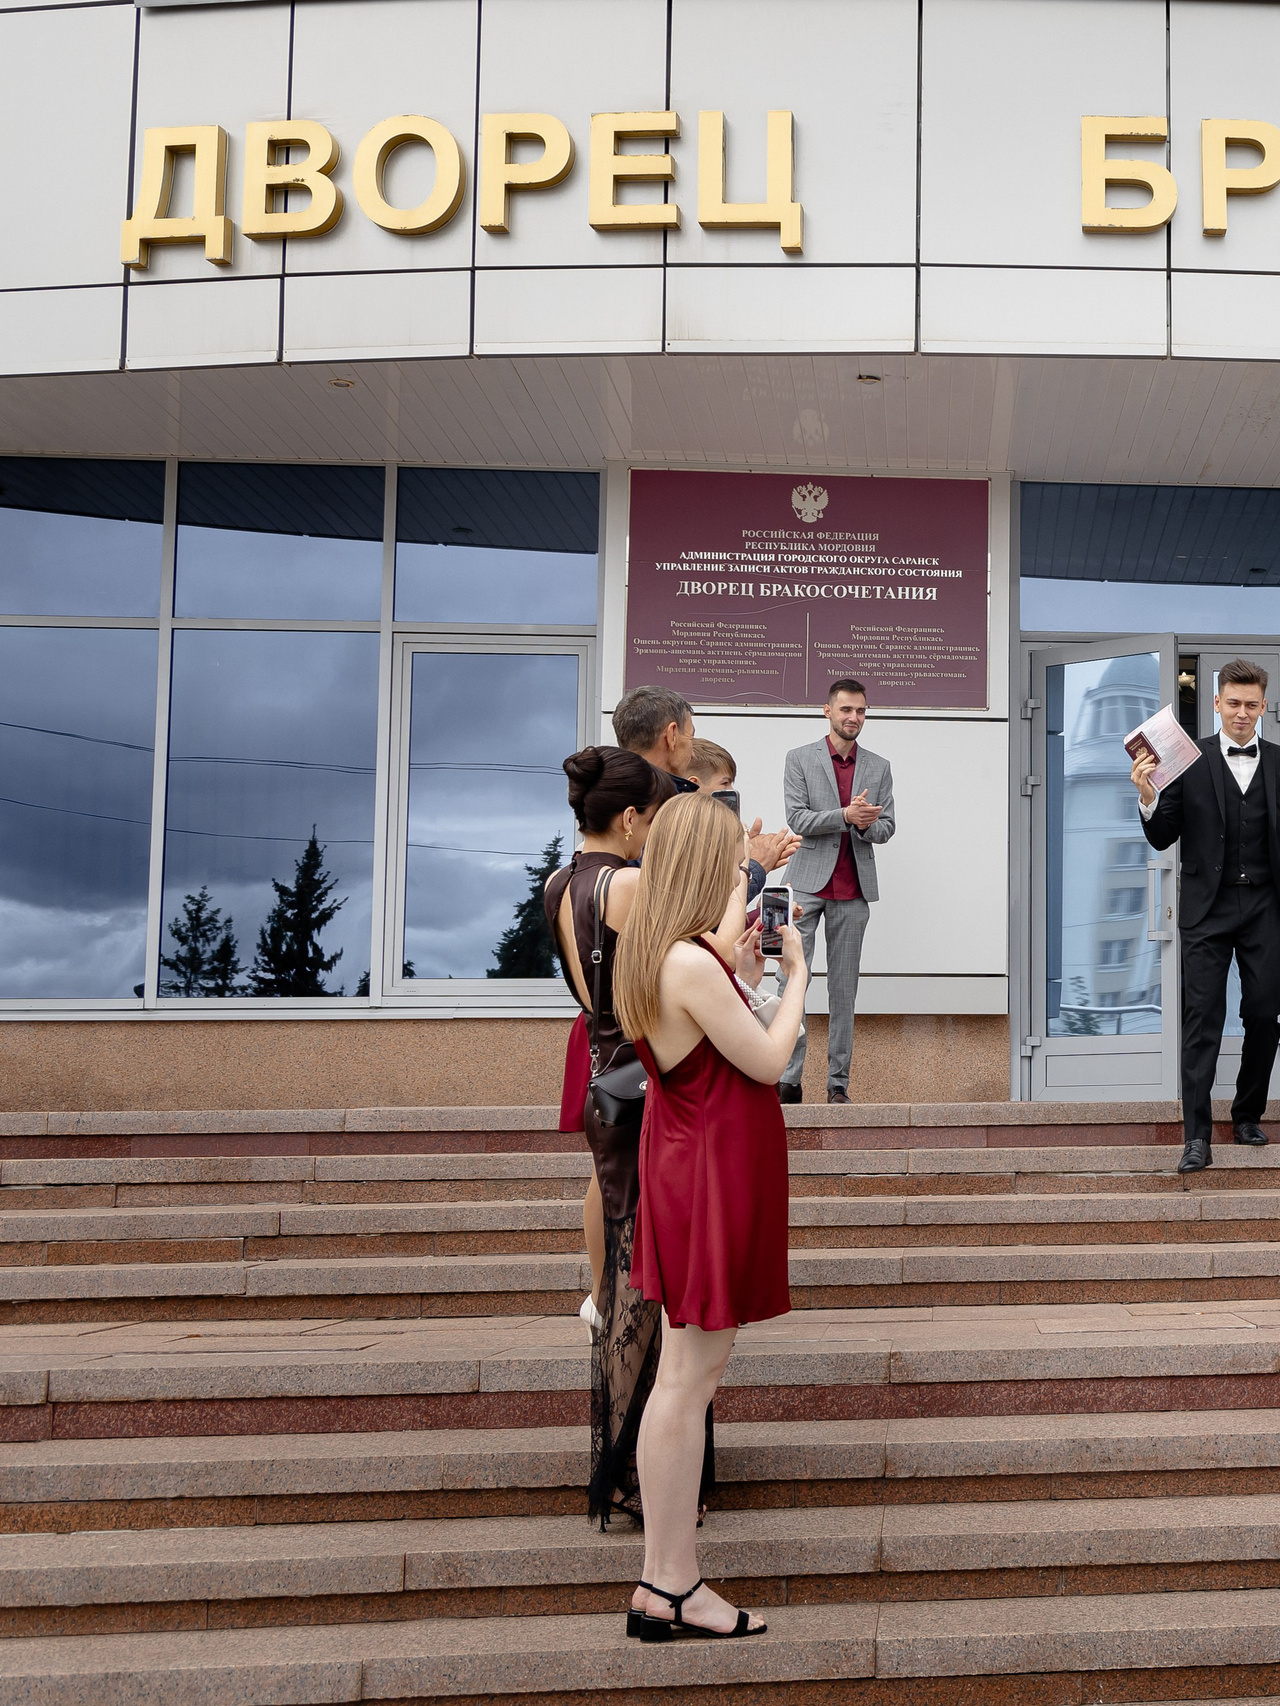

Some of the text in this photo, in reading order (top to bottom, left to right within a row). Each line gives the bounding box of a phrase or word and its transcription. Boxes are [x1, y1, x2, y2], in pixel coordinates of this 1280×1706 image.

[121, 110, 804, 271] ДВОРЕЦ
[742, 529, 878, 541] РОССИЙСКАЯ ФЕДЕРАЦИЯ
[746, 542, 875, 552] РЕСПУБЛИКА МОРДОВИЯ
[680, 552, 939, 565] АДМИНИСТРАЦИЯ ГОРОДСКОГО ОКРУГА САРАНСК
[656, 563, 725, 571] УПРАВЛЕНИЕ
[728, 564, 770, 572] ЗАПИСИ
[811, 566, 895, 575] ГРАЖДАНСКОГО
[898, 569, 962, 577] СОСТОЯНИЯ
[676, 581, 937, 600] ДВОРЕЦ БРАКОСОЧЕТАНИЯ
[717, 622, 767, 630] Федерациясь
[896, 626, 944, 634] Федерациясь
[672, 630, 765, 639] Мордовия Республикась
[852, 634, 889, 642] Мордовия
[880, 643, 911, 651] Саранск
